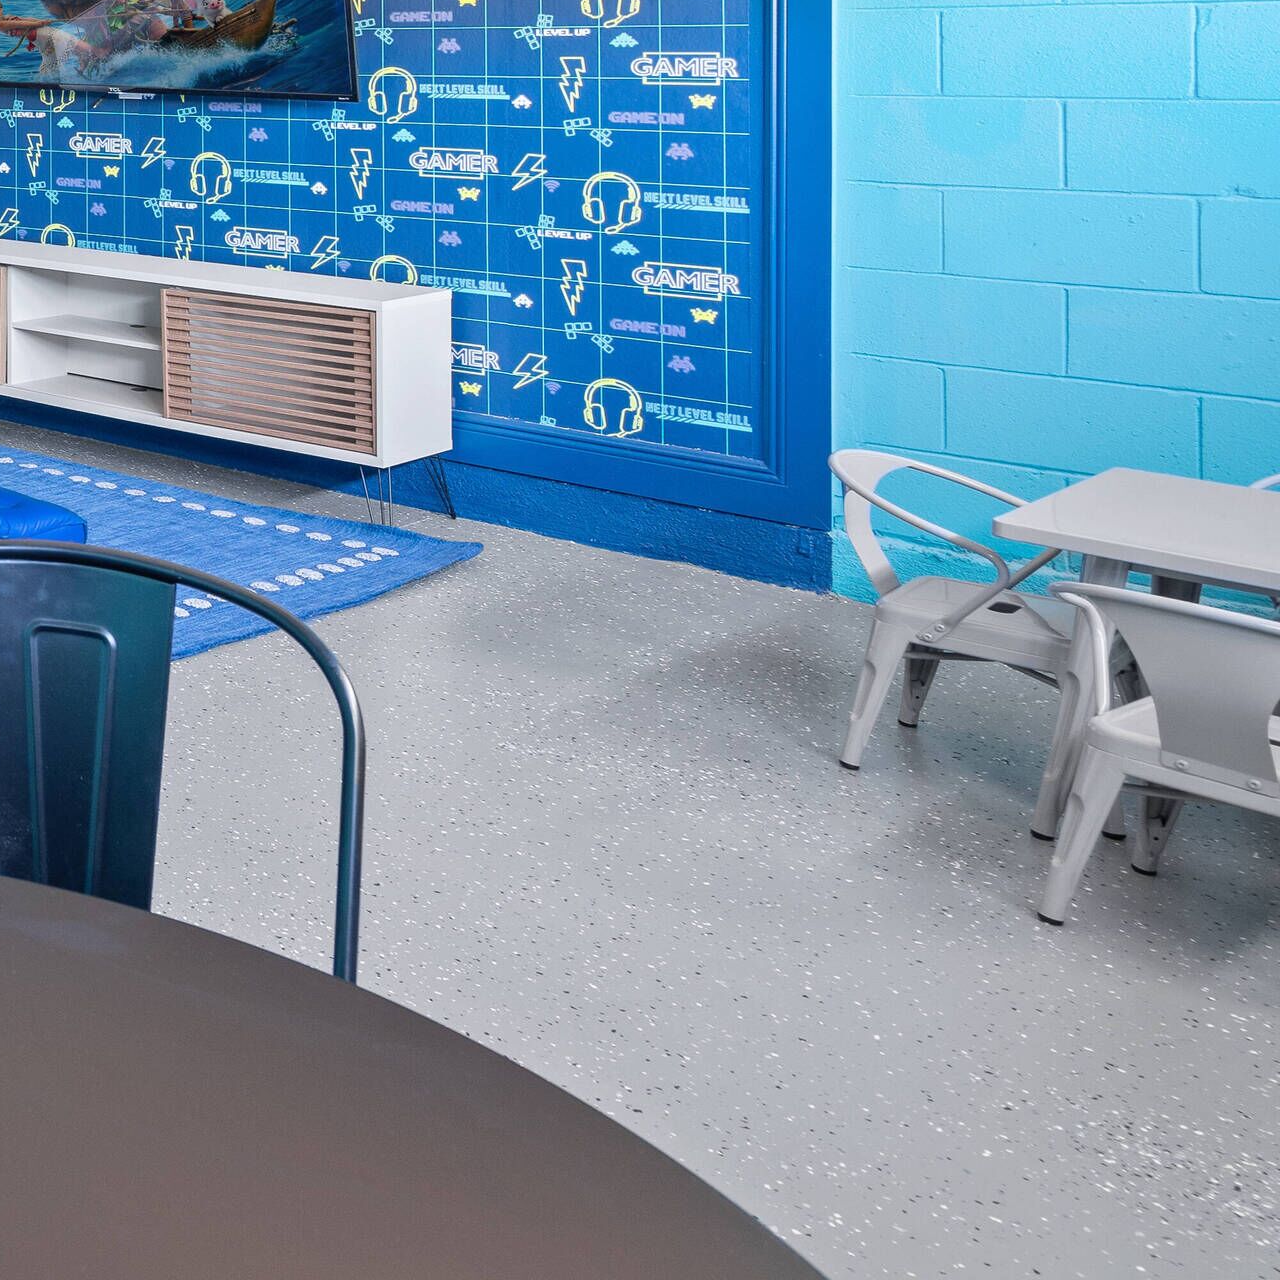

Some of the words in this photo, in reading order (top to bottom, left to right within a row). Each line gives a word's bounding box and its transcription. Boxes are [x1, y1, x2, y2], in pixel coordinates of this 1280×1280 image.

[630, 56, 738, 77] GAMER
[419, 84, 445, 93] NEXT
[446, 84, 476, 94] LEVEL
[478, 84, 506, 95] SKILL
[69, 136, 132, 154] GAMER
[409, 151, 498, 173] GAMER
[643, 191, 674, 204] NEXT
[675, 193, 712, 206] LEVEL
[714, 196, 749, 208] SKILL
[224, 230, 299, 252] GAMER
[537, 229, 574, 239] LEVEL
[575, 232, 592, 240] UP
[631, 266, 740, 294] GAMER
[450, 346, 500, 370] MER
[645, 401, 676, 416] NEXT
[677, 406, 714, 421] LEVEL
[716, 411, 751, 427] SKILL
